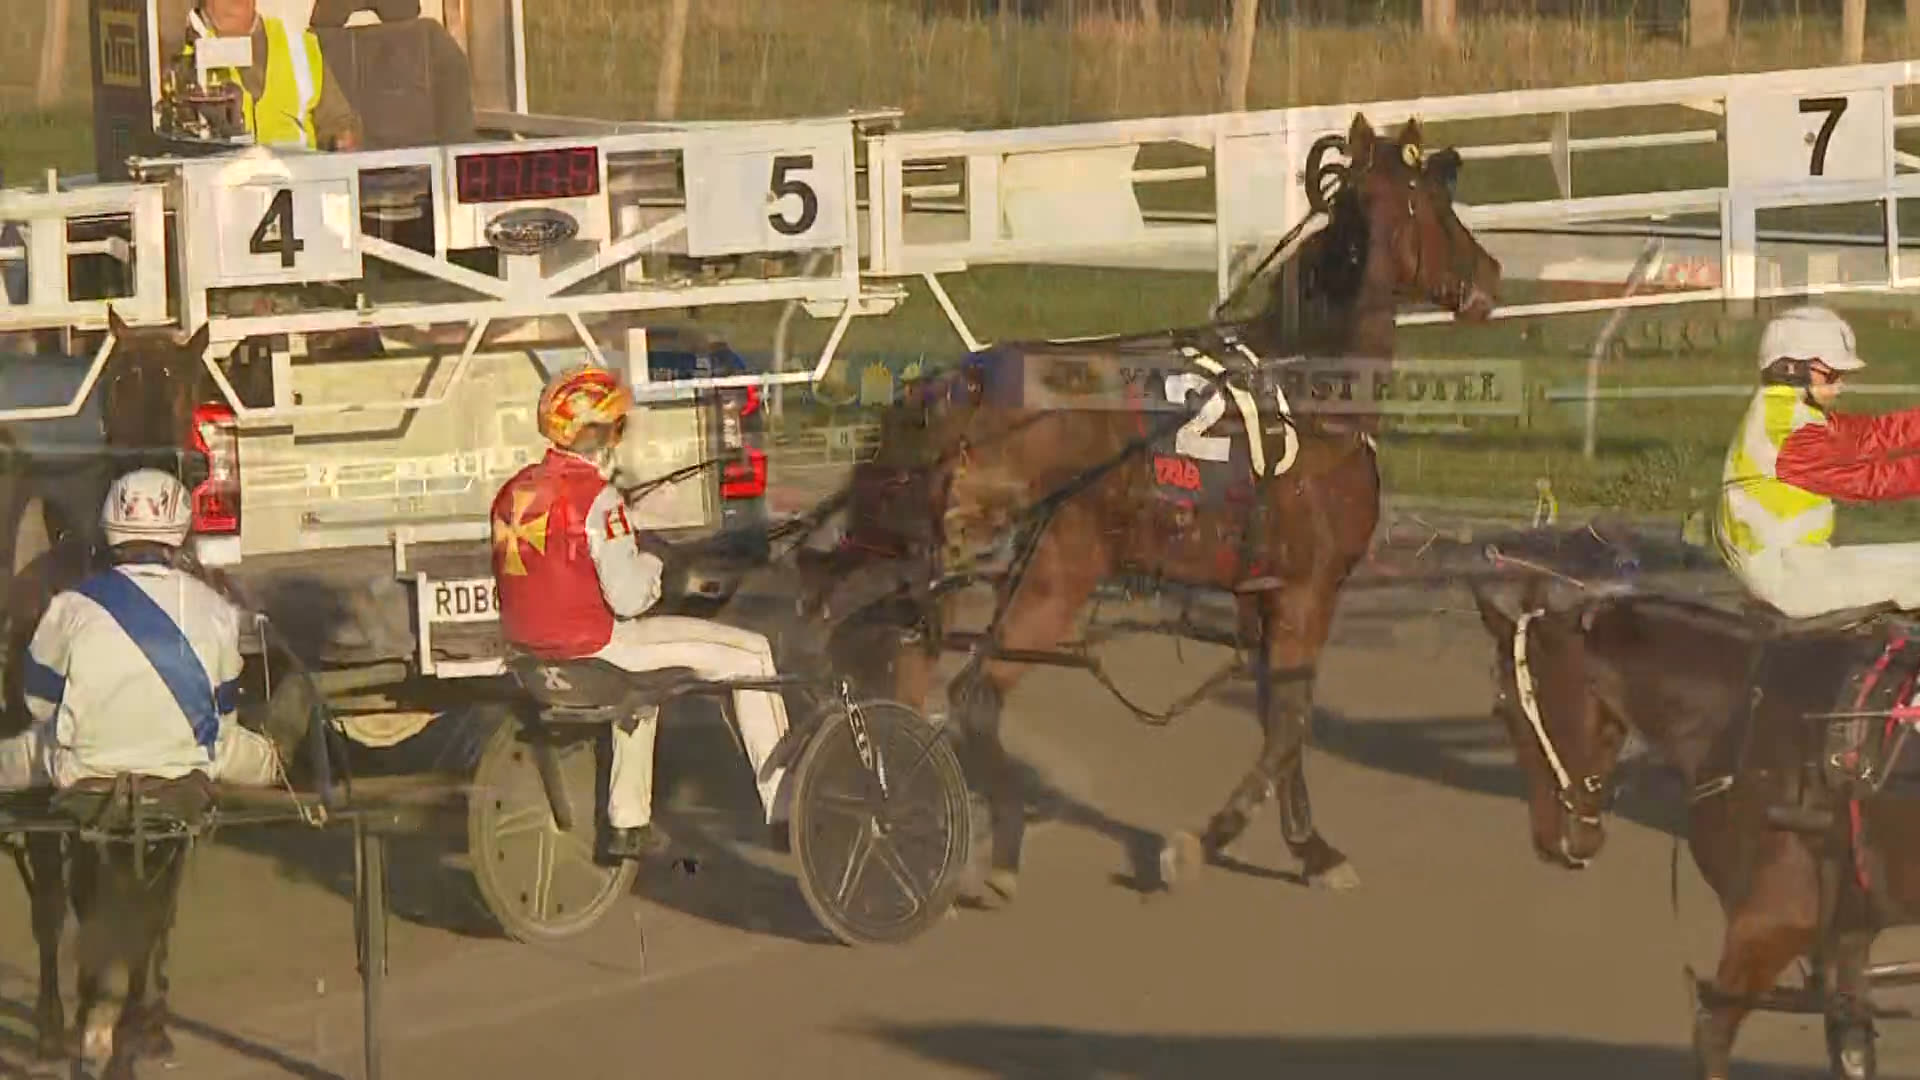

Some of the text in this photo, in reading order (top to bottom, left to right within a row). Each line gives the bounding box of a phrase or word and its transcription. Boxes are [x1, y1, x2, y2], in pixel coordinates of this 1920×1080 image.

[1305, 134, 1350, 213] 6
[1799, 96, 1848, 176] 7
[249, 188, 305, 268] 4
[768, 154, 818, 235] 5
